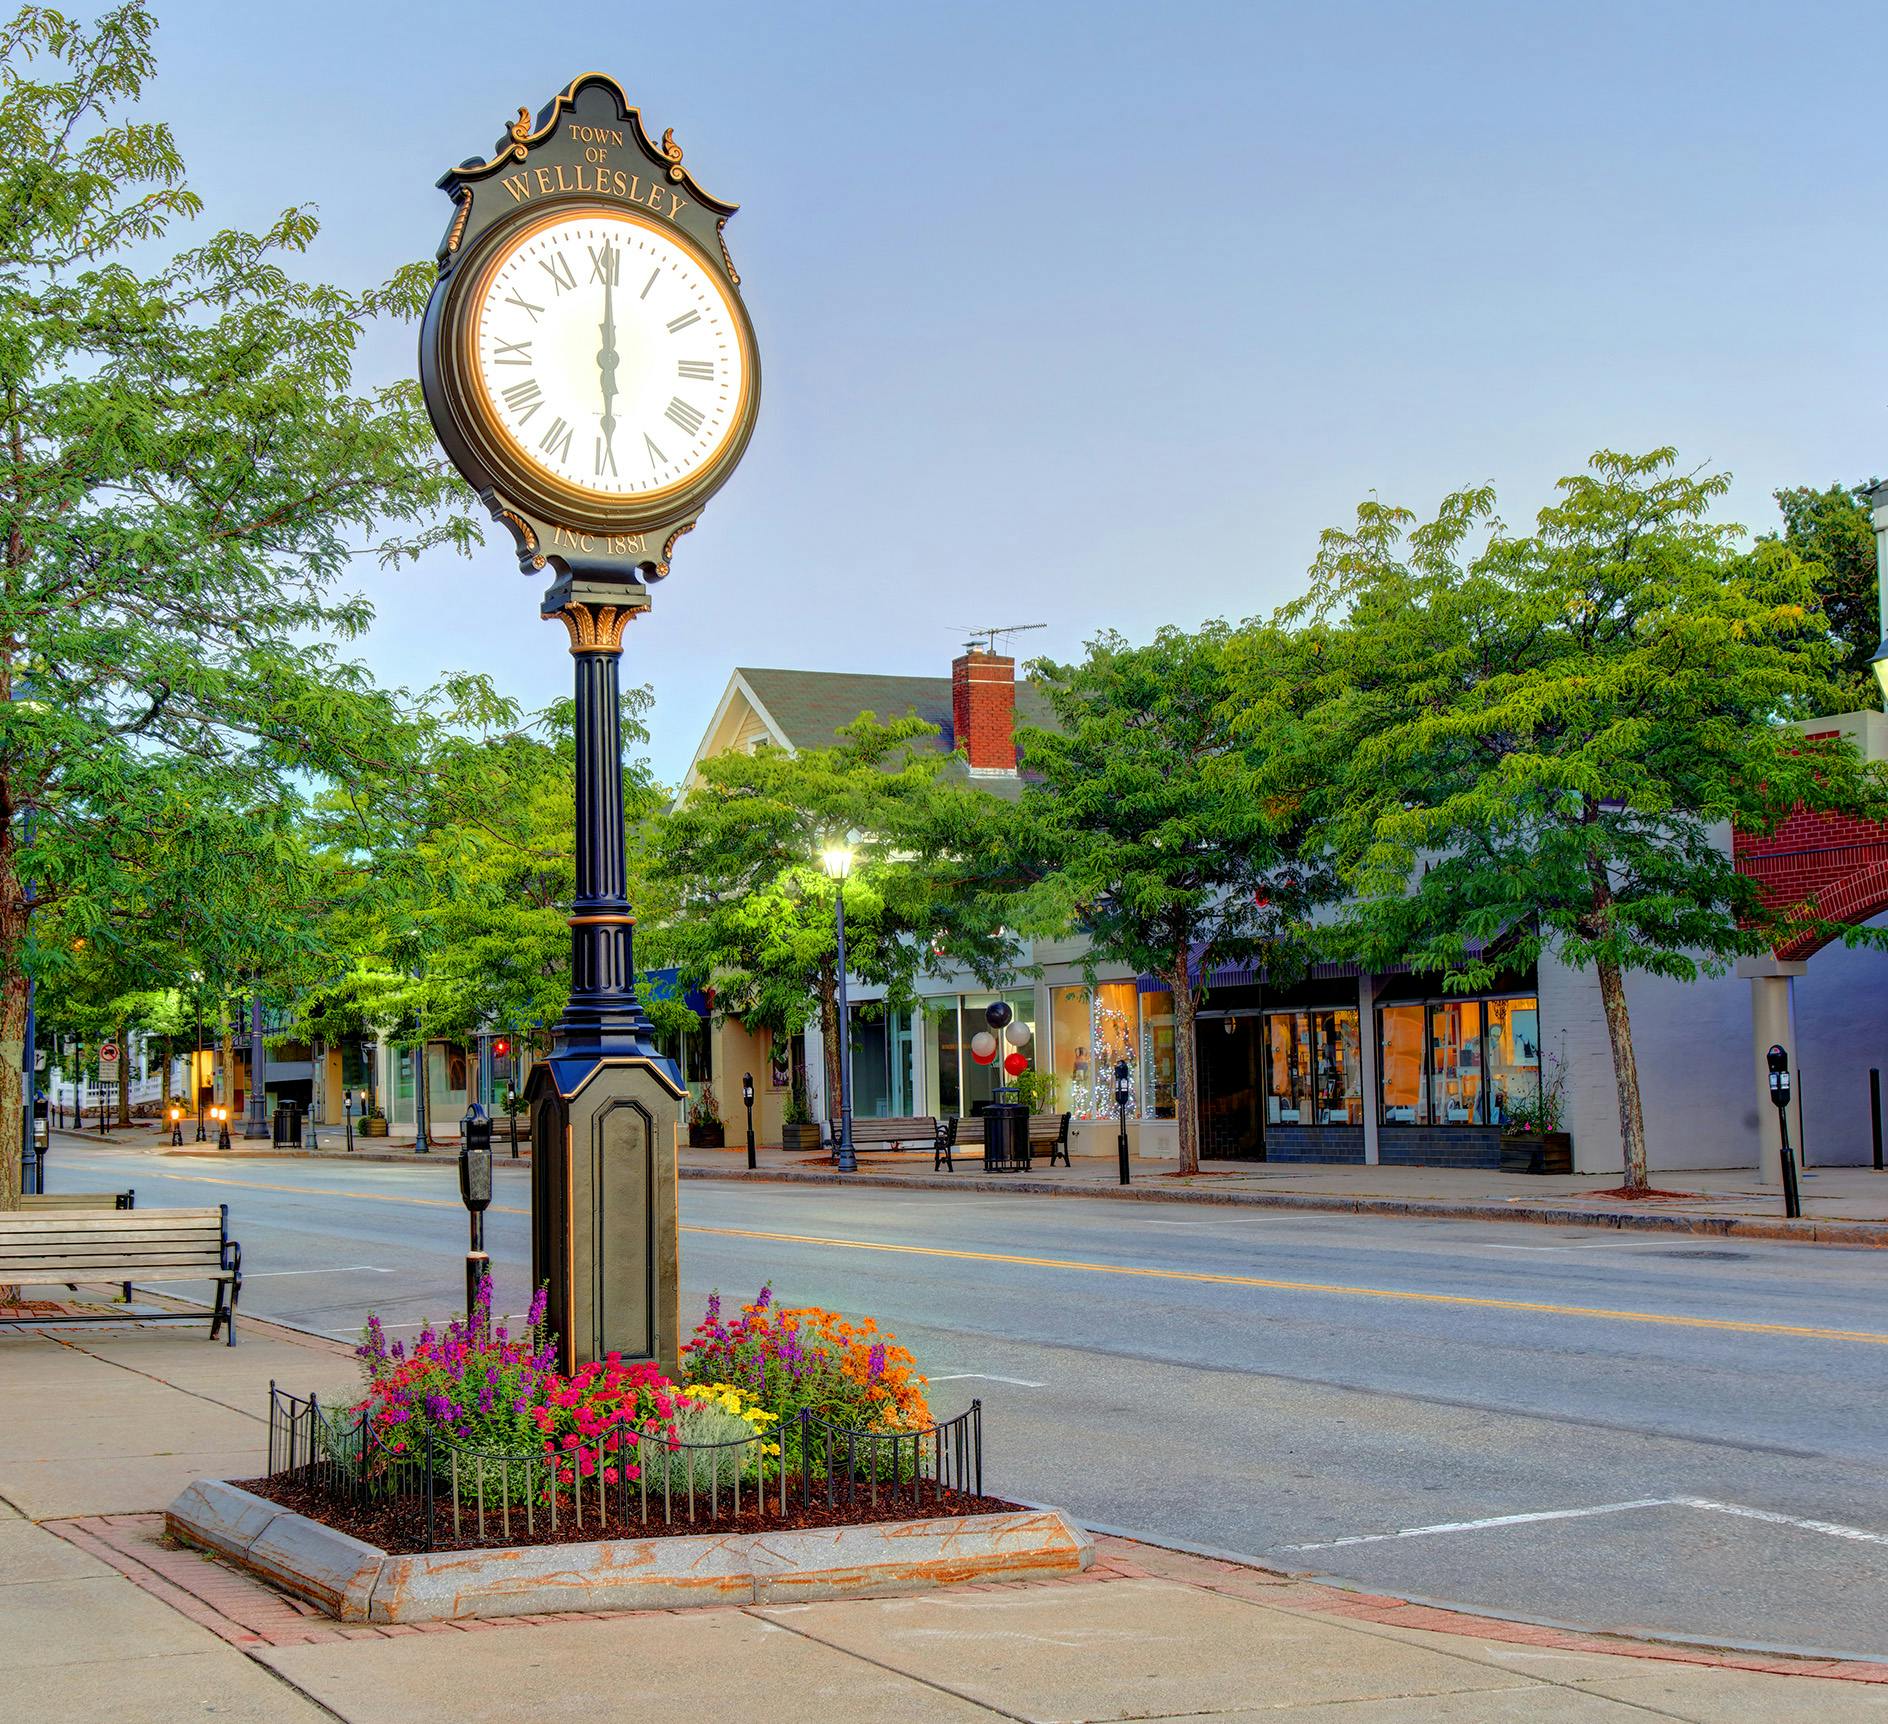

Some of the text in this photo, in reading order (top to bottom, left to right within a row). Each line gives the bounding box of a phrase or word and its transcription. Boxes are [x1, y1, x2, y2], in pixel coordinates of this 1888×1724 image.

[568, 124, 624, 148] TOWN
[585, 147, 608, 164] OF
[501, 165, 688, 221] WELLESLEY
[553, 527, 648, 555] INC 1881
